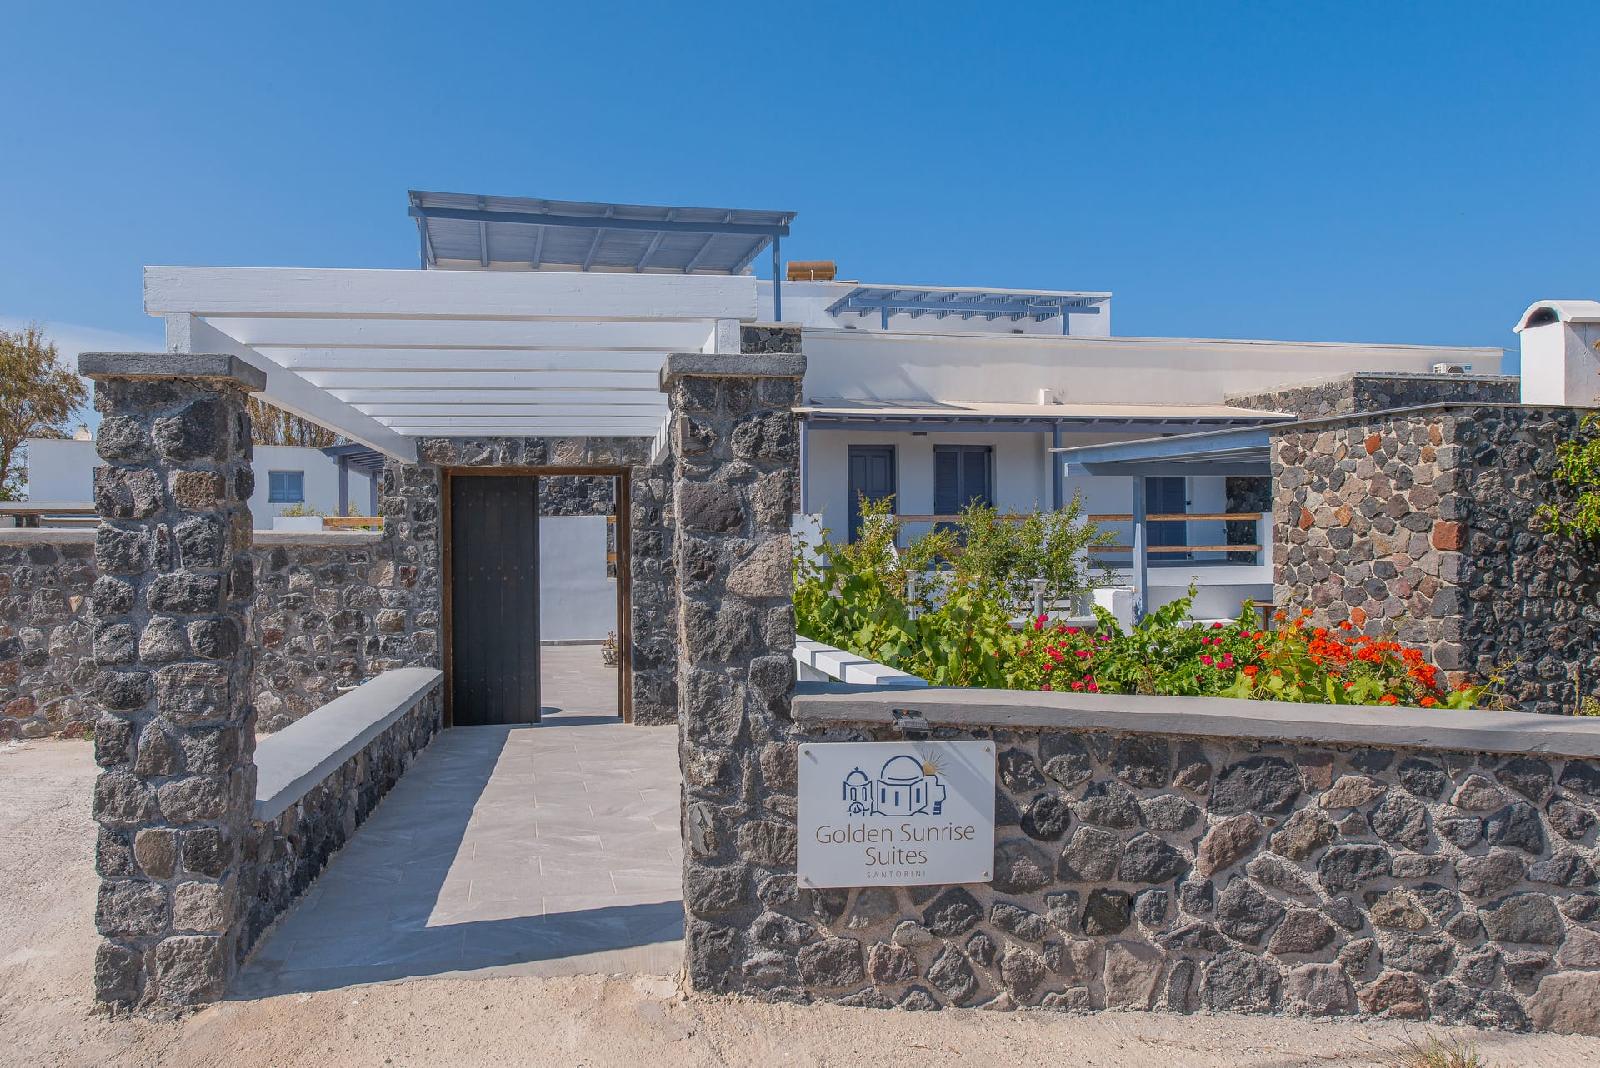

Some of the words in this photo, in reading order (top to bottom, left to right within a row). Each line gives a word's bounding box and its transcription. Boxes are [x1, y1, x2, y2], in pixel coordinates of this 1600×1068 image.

[816, 823, 893, 844] Golden
[900, 822, 975, 842] Sunrise
[865, 846, 928, 866] Suites
[866, 870, 926, 879] SANTORINI
